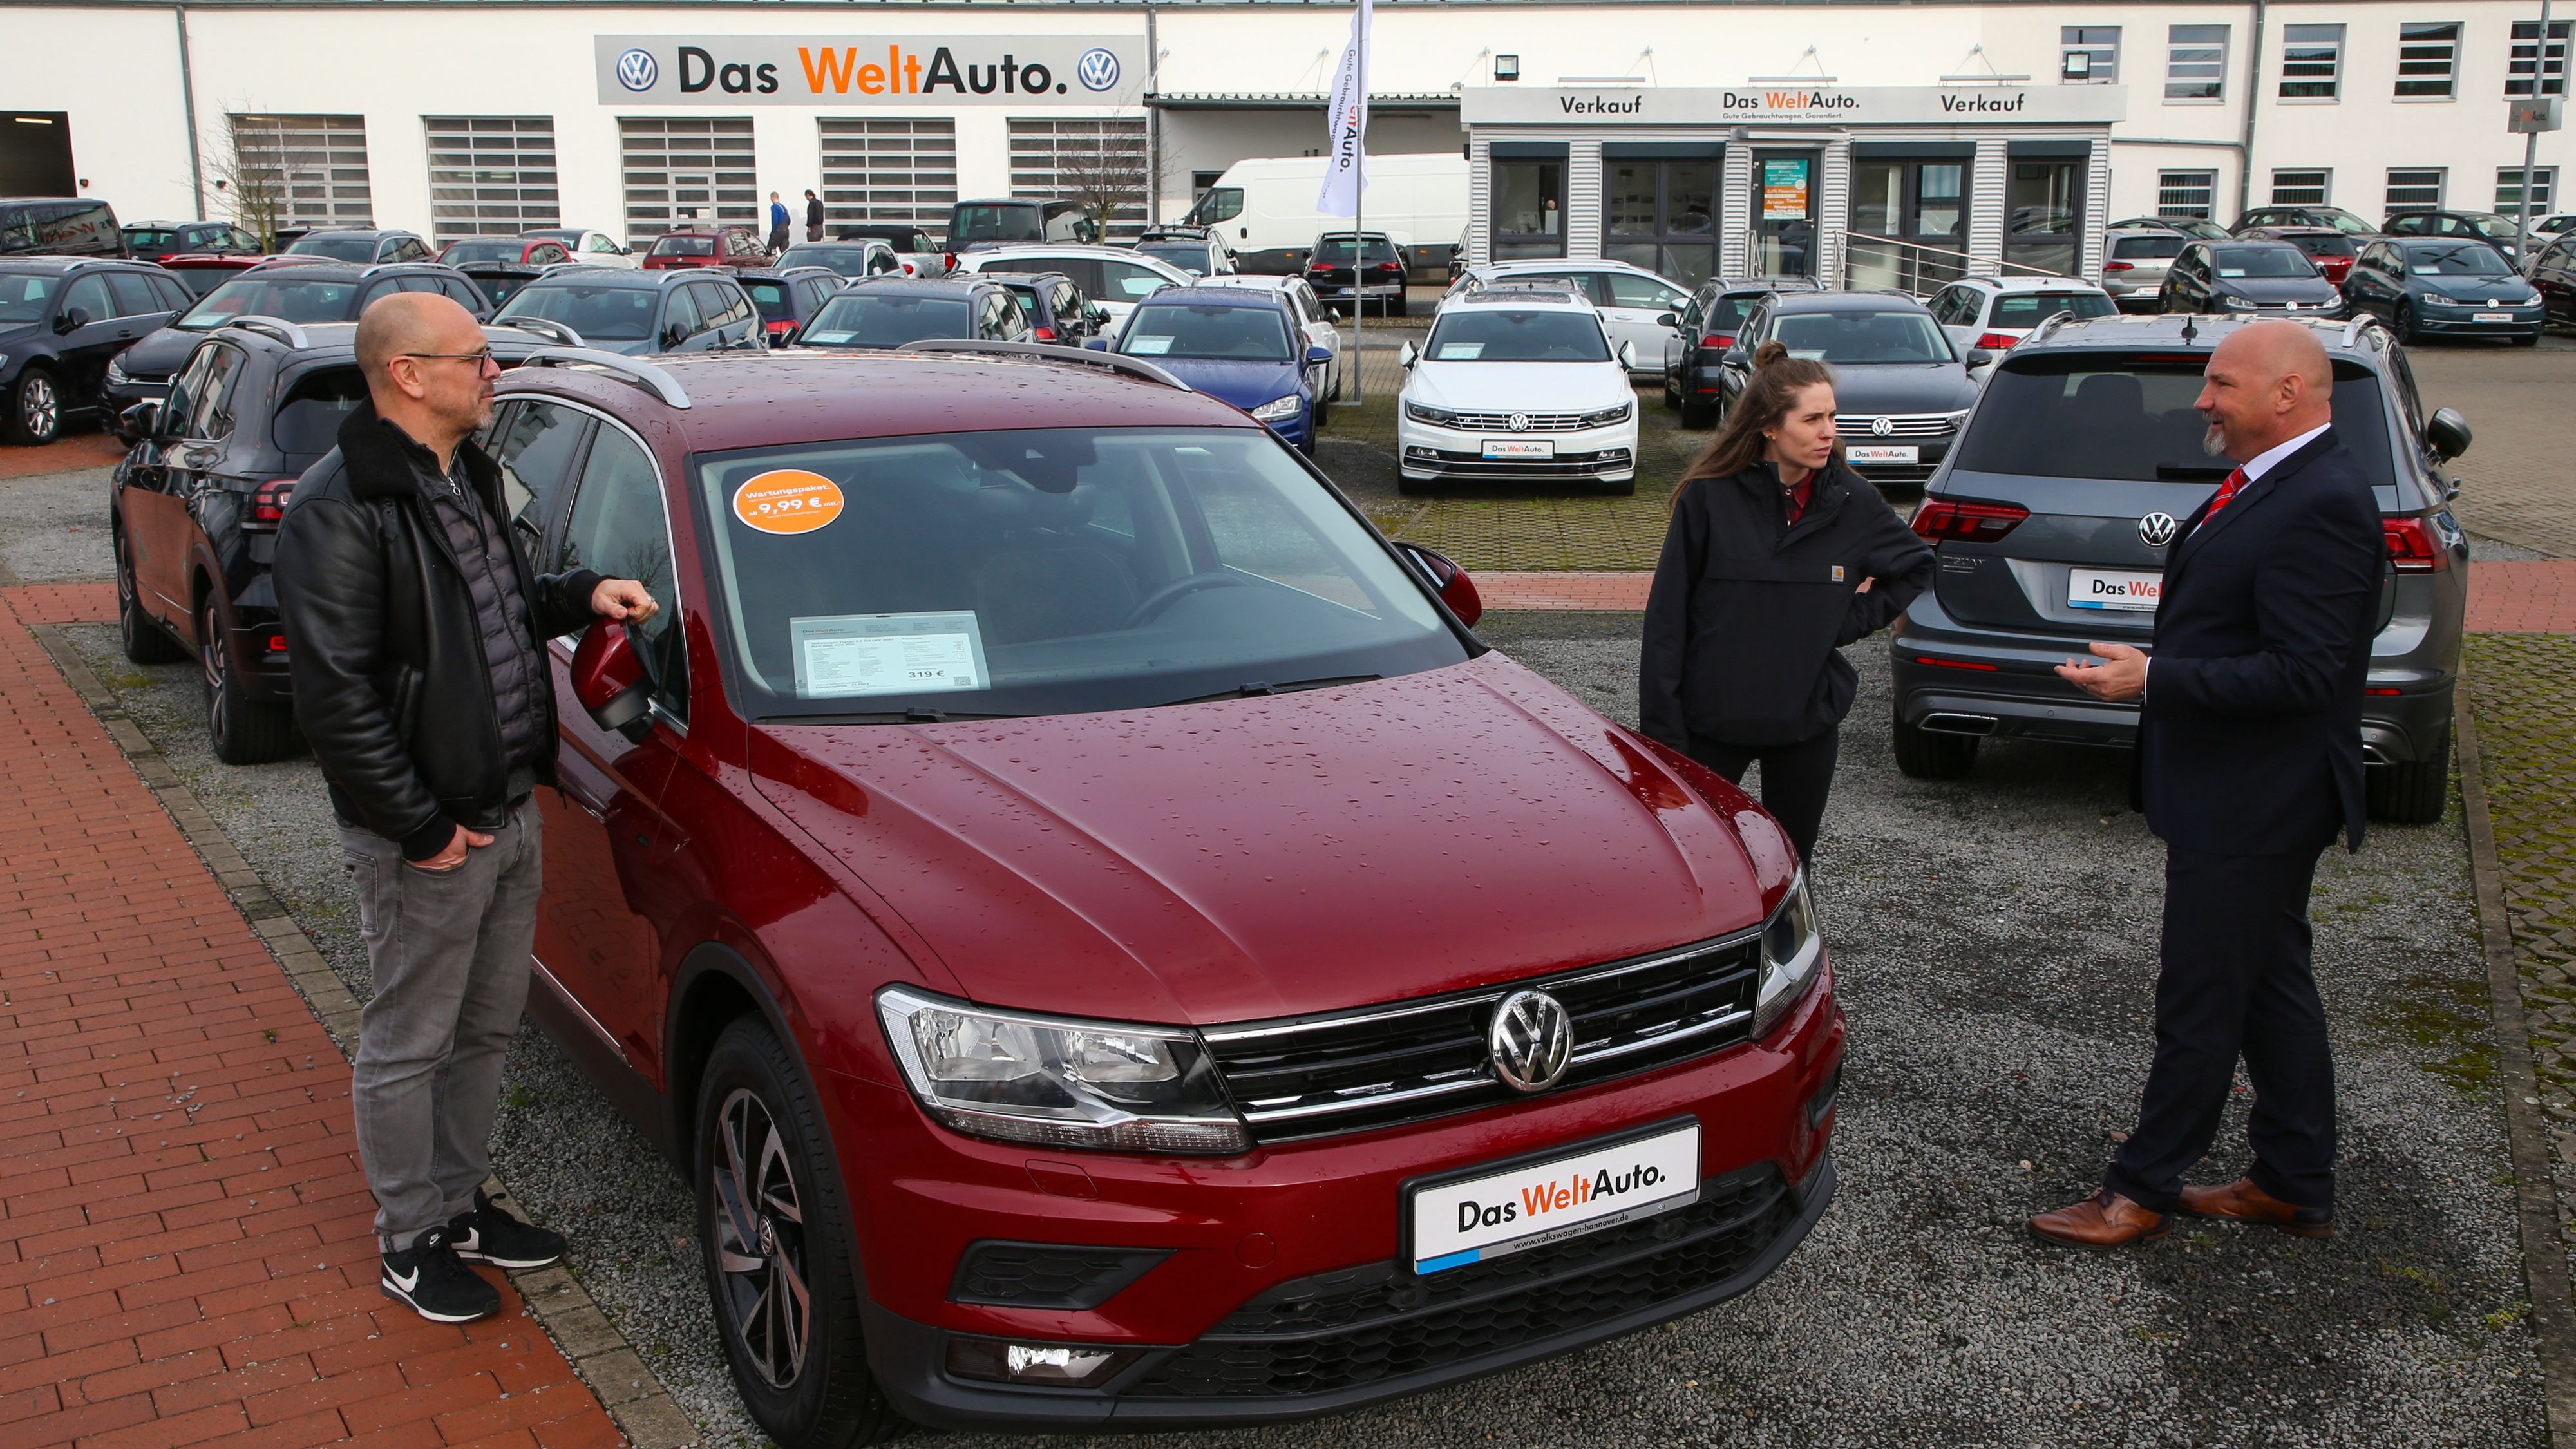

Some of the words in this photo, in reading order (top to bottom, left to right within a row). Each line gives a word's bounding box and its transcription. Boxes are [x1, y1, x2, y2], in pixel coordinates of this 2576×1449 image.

[678, 47, 779, 94] Das
[798, 45, 1067, 95] WeltAuto.
[1346, 49, 1356, 71] Gute
[1560, 95, 1642, 113] Verkauf
[1723, 92, 1758, 108] Das
[1766, 91, 1859, 108] WeltAuto.
[1941, 93, 2024, 111] Verkauf
[1331, 73, 1352, 151] Gebrauchtwage
[746, 484, 830, 498] Wartungspaket.
[758, 499, 803, 515] 9,99
[808, 497, 822, 507] €
[2093, 579, 2125, 595] Das
[2128, 581, 2163, 598] Wel
[1489, 989, 1574, 1091] VW
[1458, 1200, 1517, 1233] Das
[1522, 1164, 1666, 1217] WeltAuto.
[1513, 1213, 1629, 1249] www.volkswagen-hannover.de
